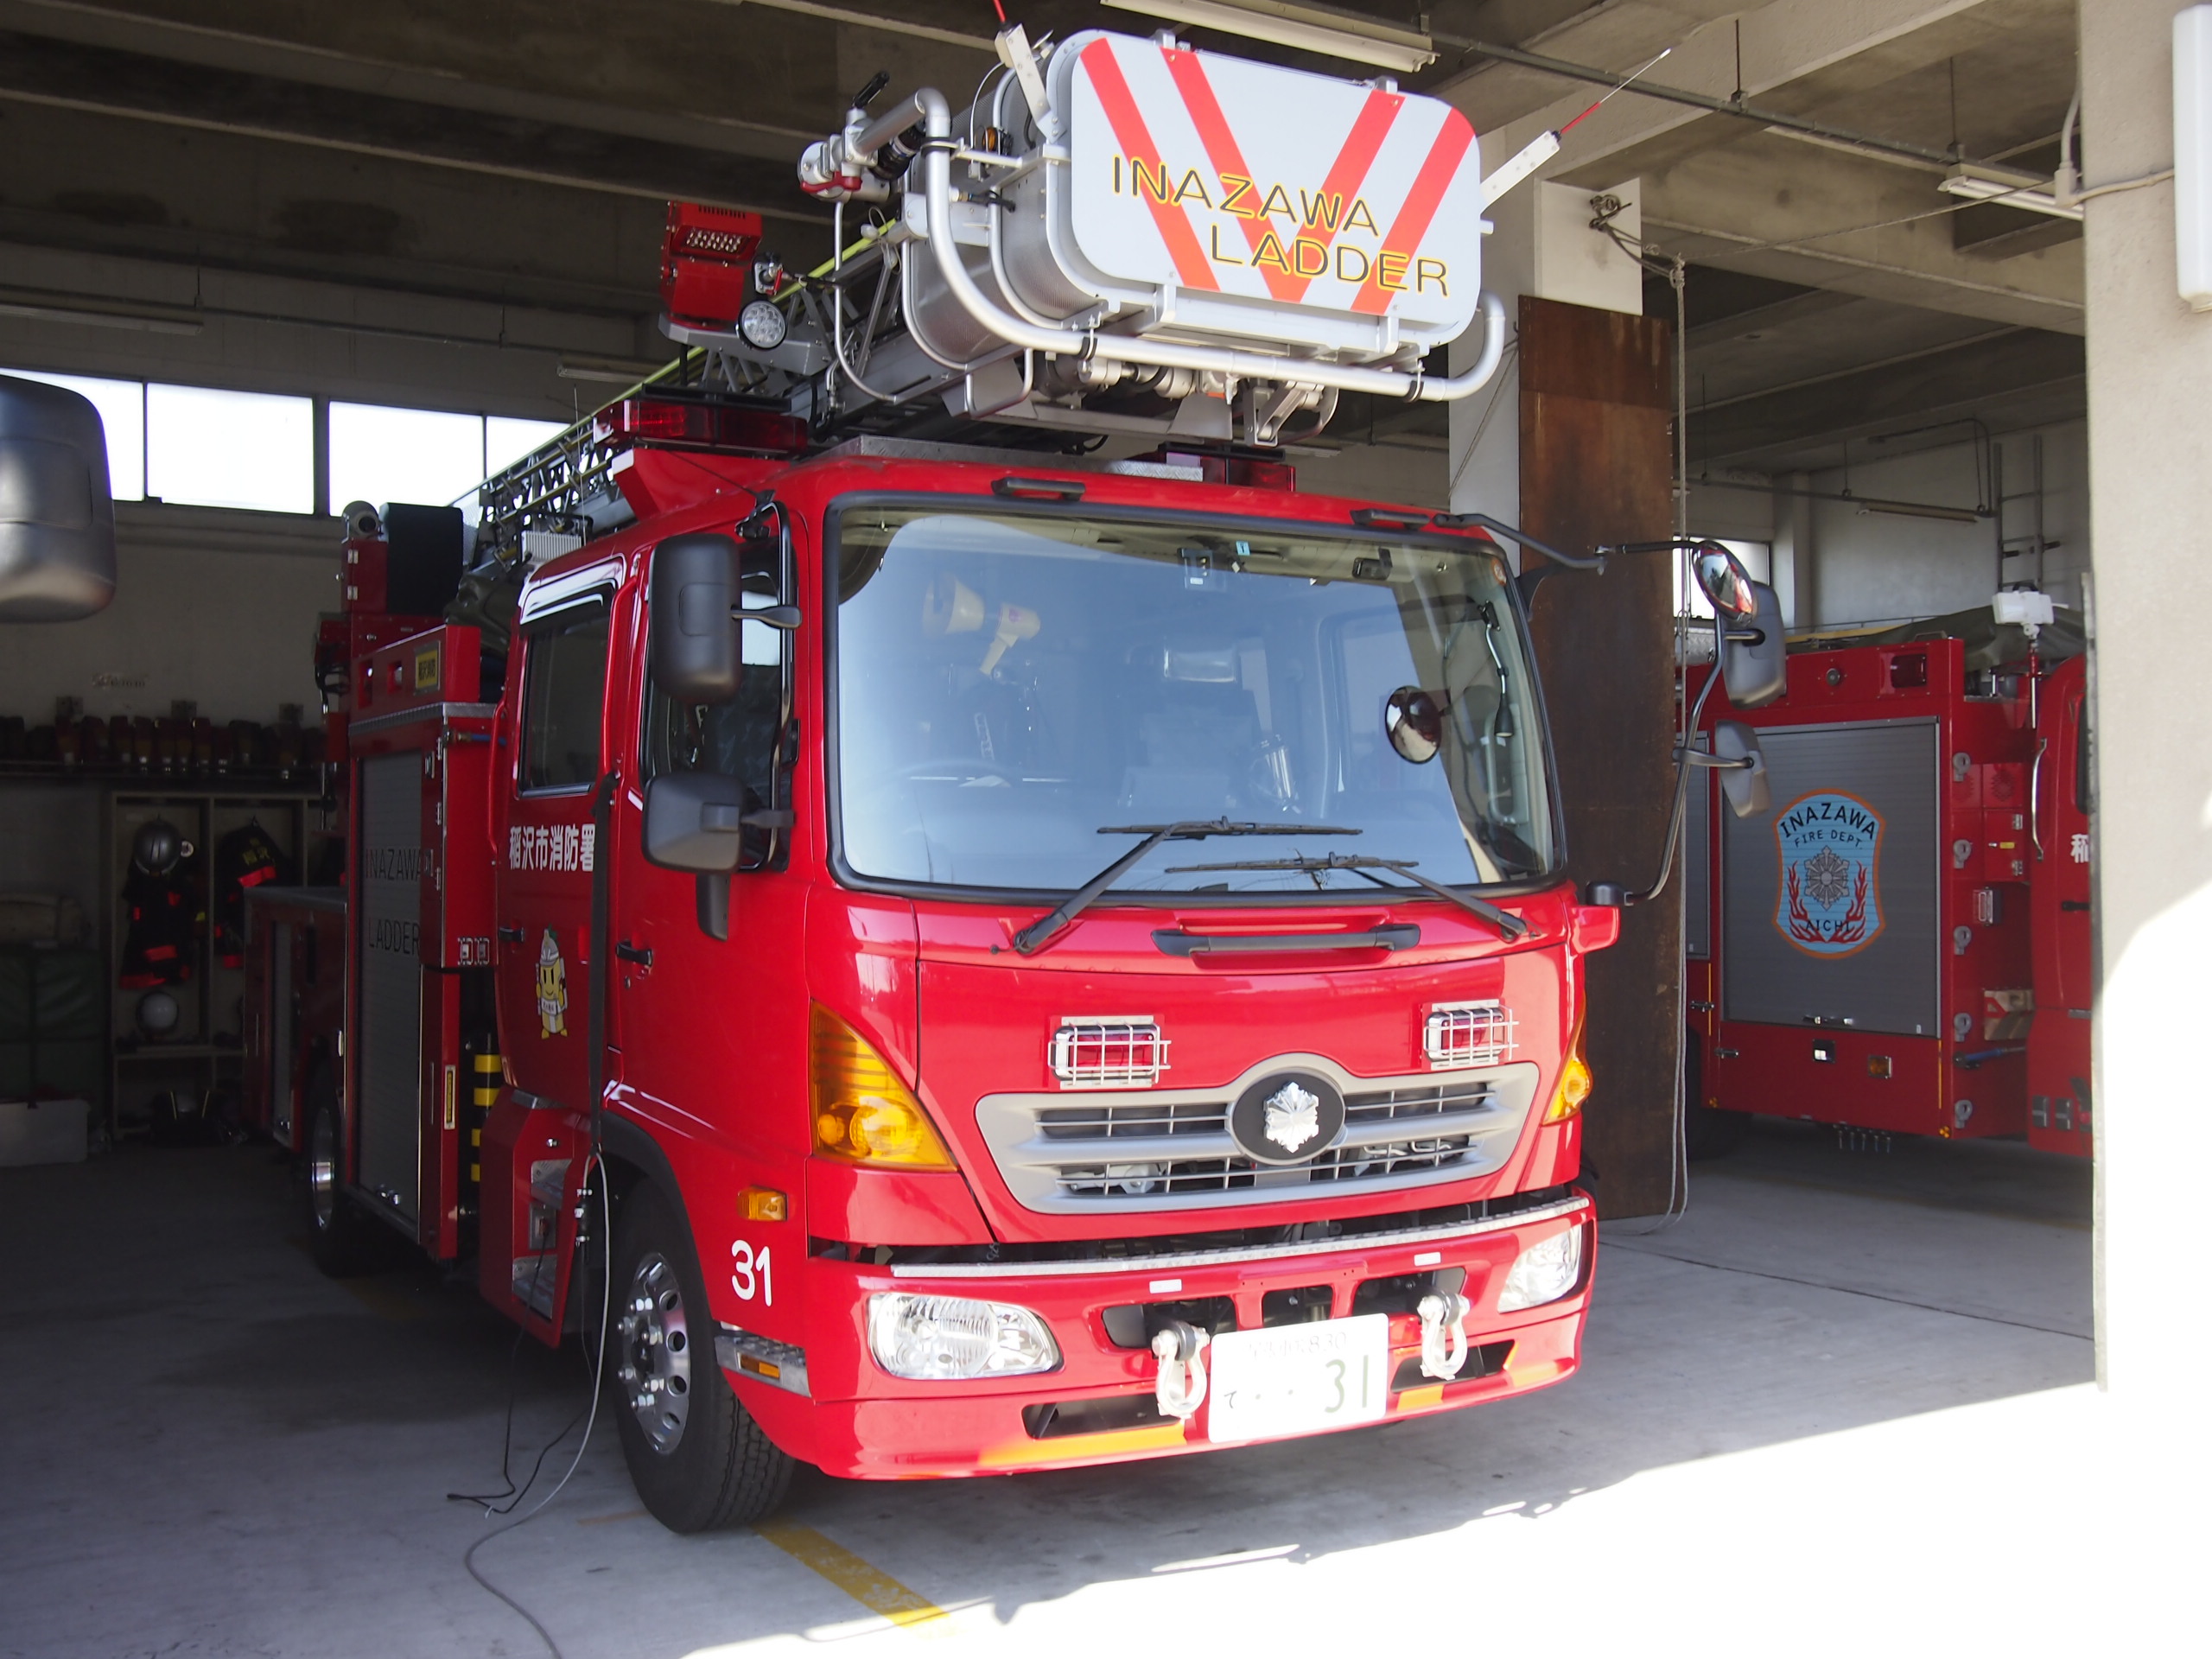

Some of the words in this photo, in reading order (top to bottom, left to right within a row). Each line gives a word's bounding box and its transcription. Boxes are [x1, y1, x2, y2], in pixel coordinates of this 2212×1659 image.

[1113, 154, 1379, 238] INAZAWA
[1211, 224, 1450, 298] LADDER
[1780, 802, 1878, 840] INAZAWA
[1794, 830, 1824, 848] FIRE
[1831, 830, 1865, 849] DEPT.
[509, 823, 595, 872] 稲沢市消防署
[368, 917, 421, 957] LADDER
[1806, 919, 1851, 932] AICHI
[732, 1239, 771, 1306] 31
